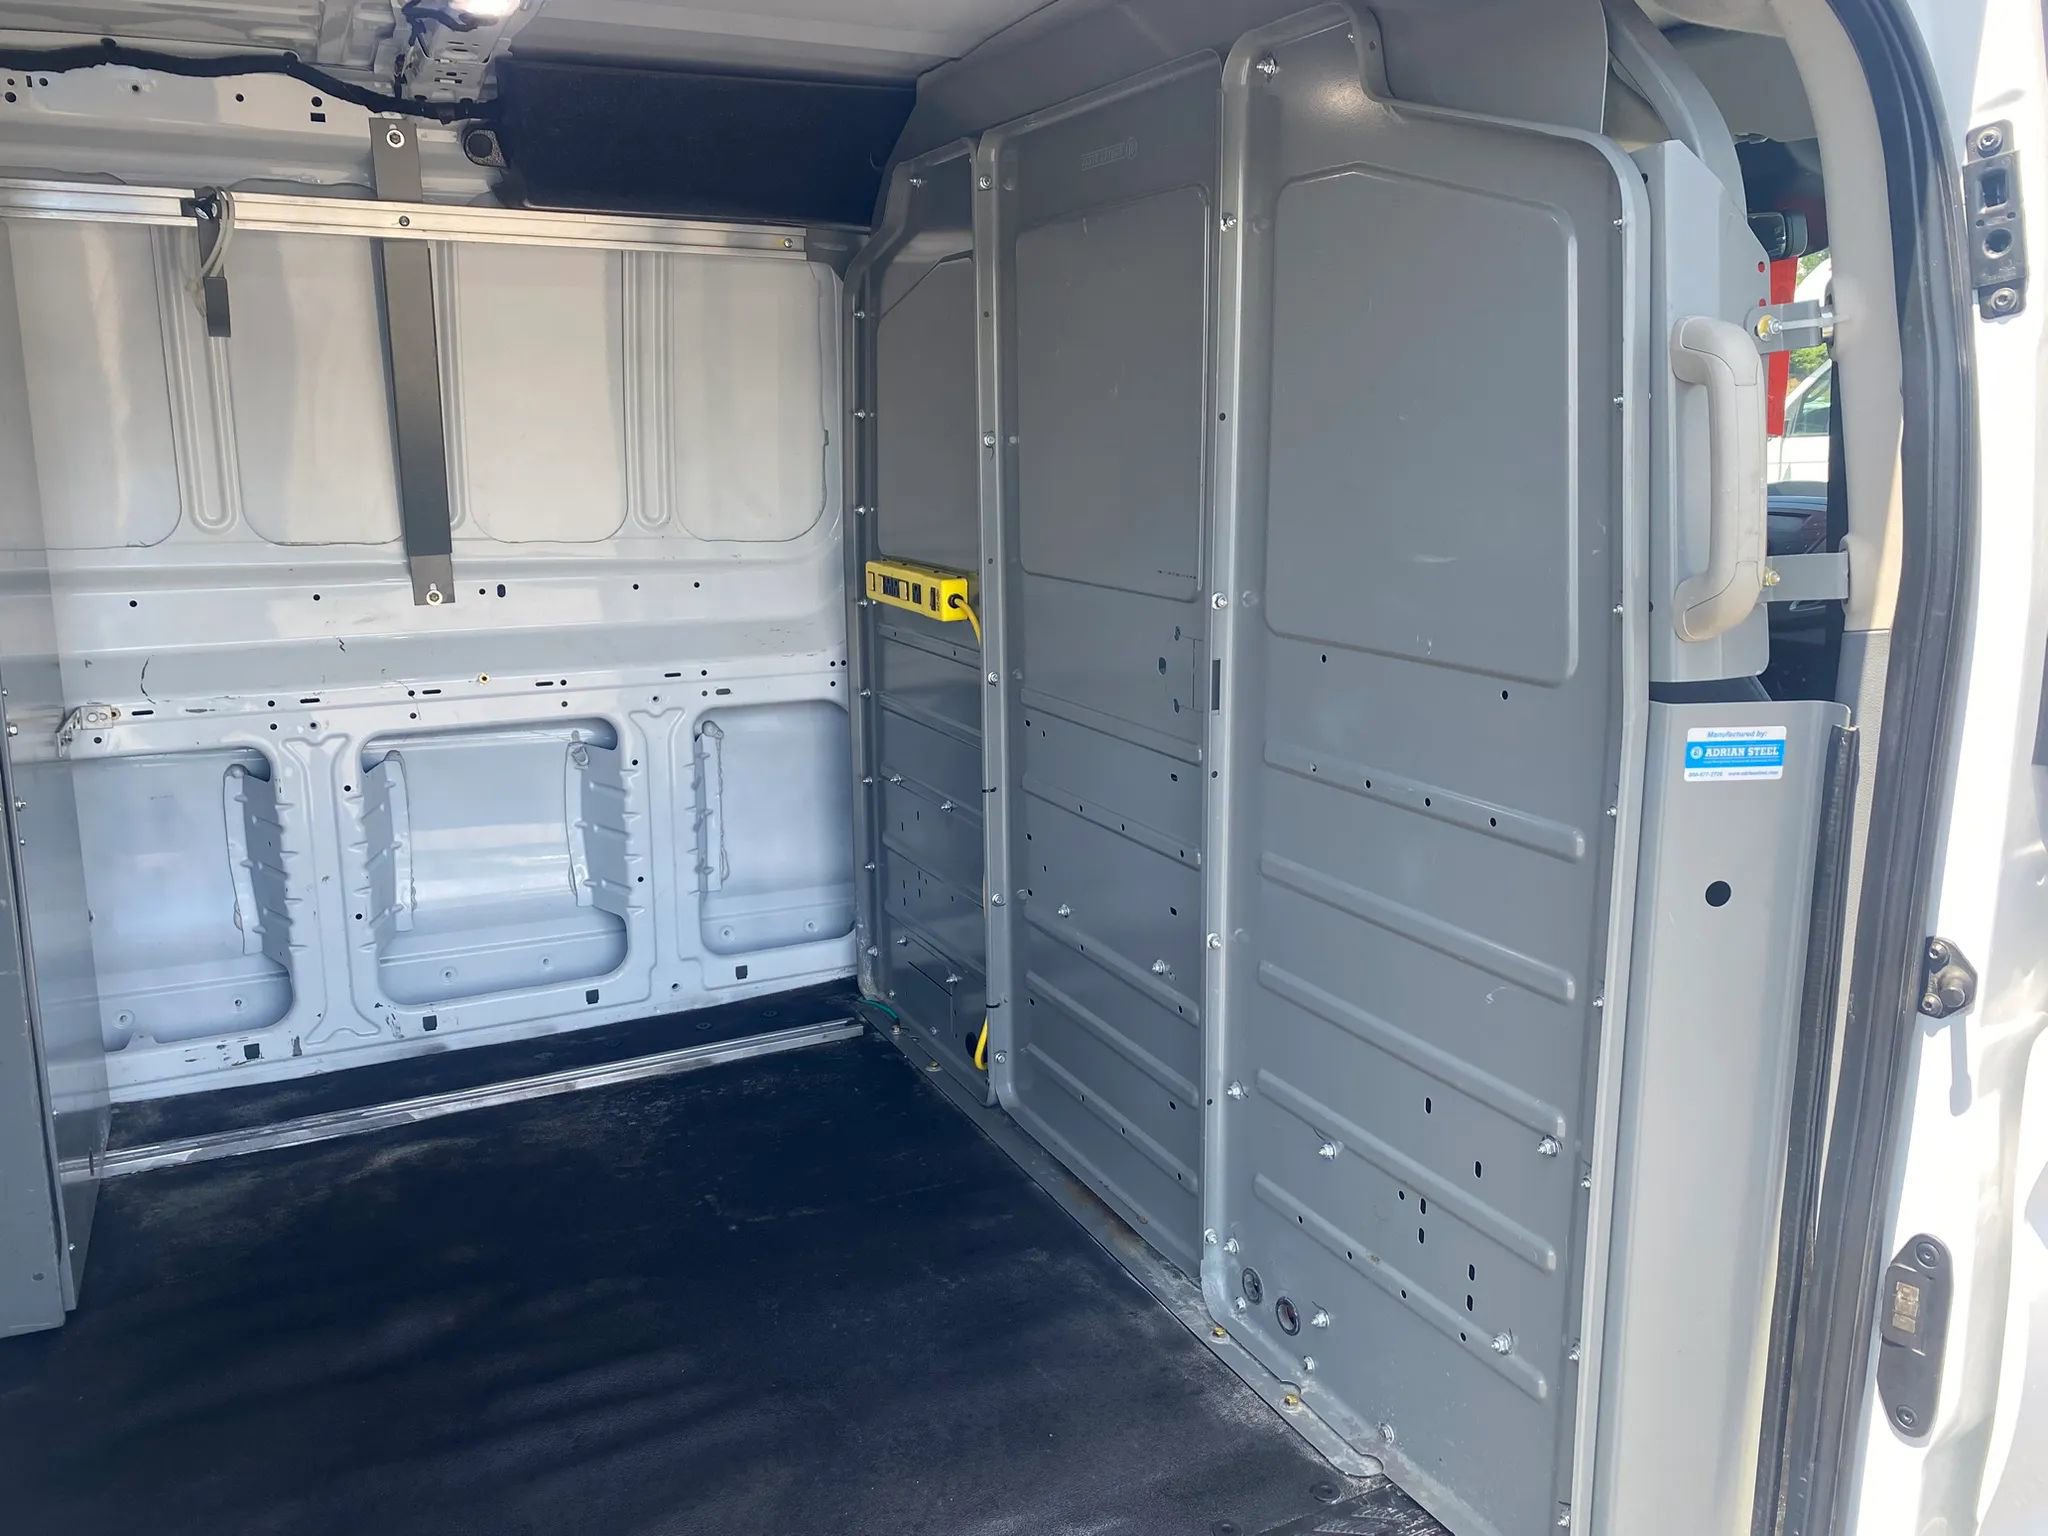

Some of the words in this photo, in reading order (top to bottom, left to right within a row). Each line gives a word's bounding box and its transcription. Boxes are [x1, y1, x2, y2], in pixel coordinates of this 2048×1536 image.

[1707, 730, 1755, 738] Manufactured
[1756, 730, 1767, 738] by:
[1705, 747, 1745, 757] ADRIAN
[1748, 746, 1779, 756] STEEL
